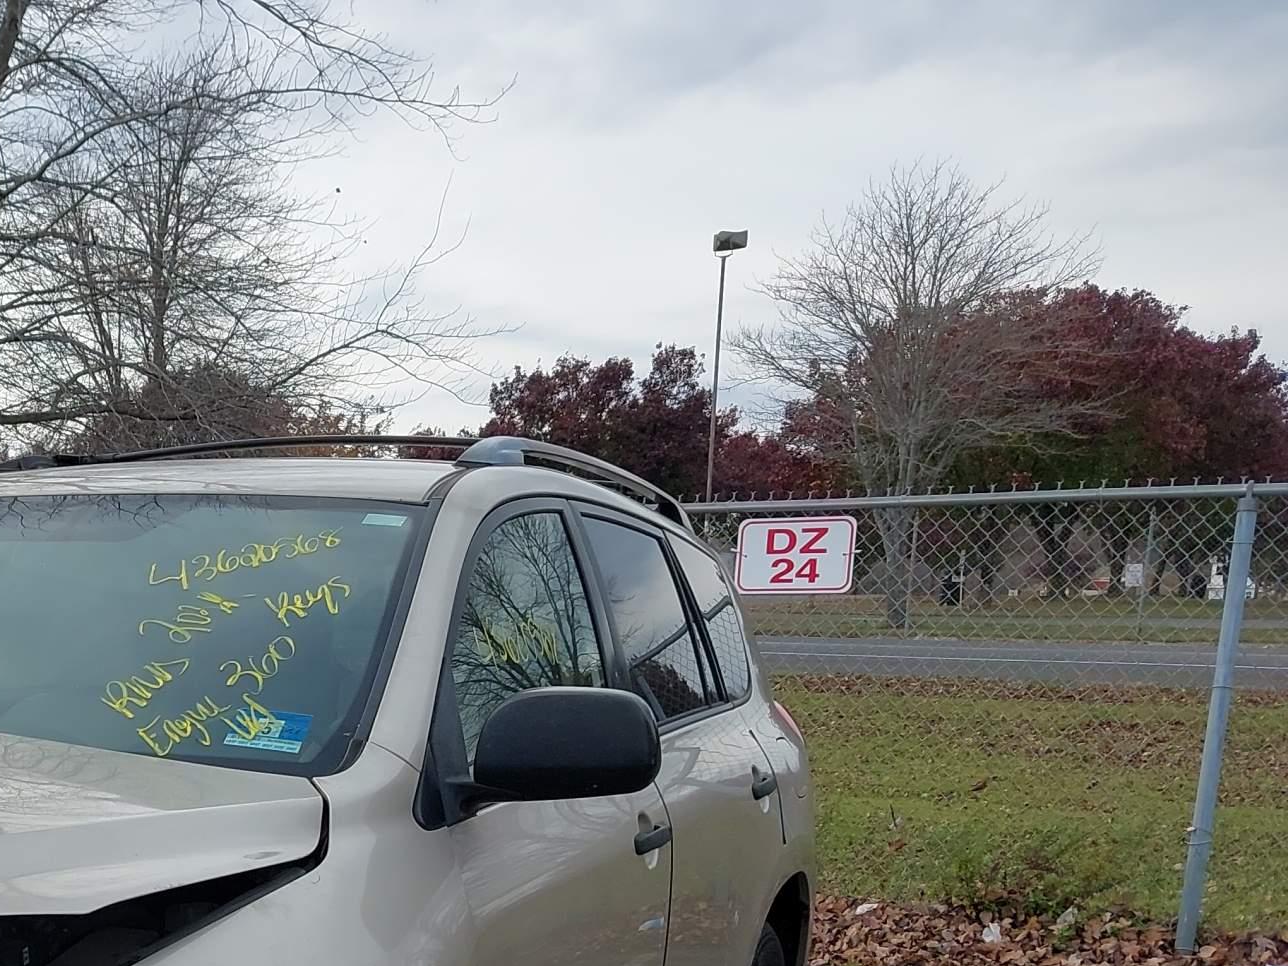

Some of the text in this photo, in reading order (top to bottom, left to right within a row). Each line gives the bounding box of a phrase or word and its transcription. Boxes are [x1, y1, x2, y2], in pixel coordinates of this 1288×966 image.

[766, 527, 829, 555] DZ
[148, 527, 343, 590] 43620568
[769, 558, 820, 584] 24
